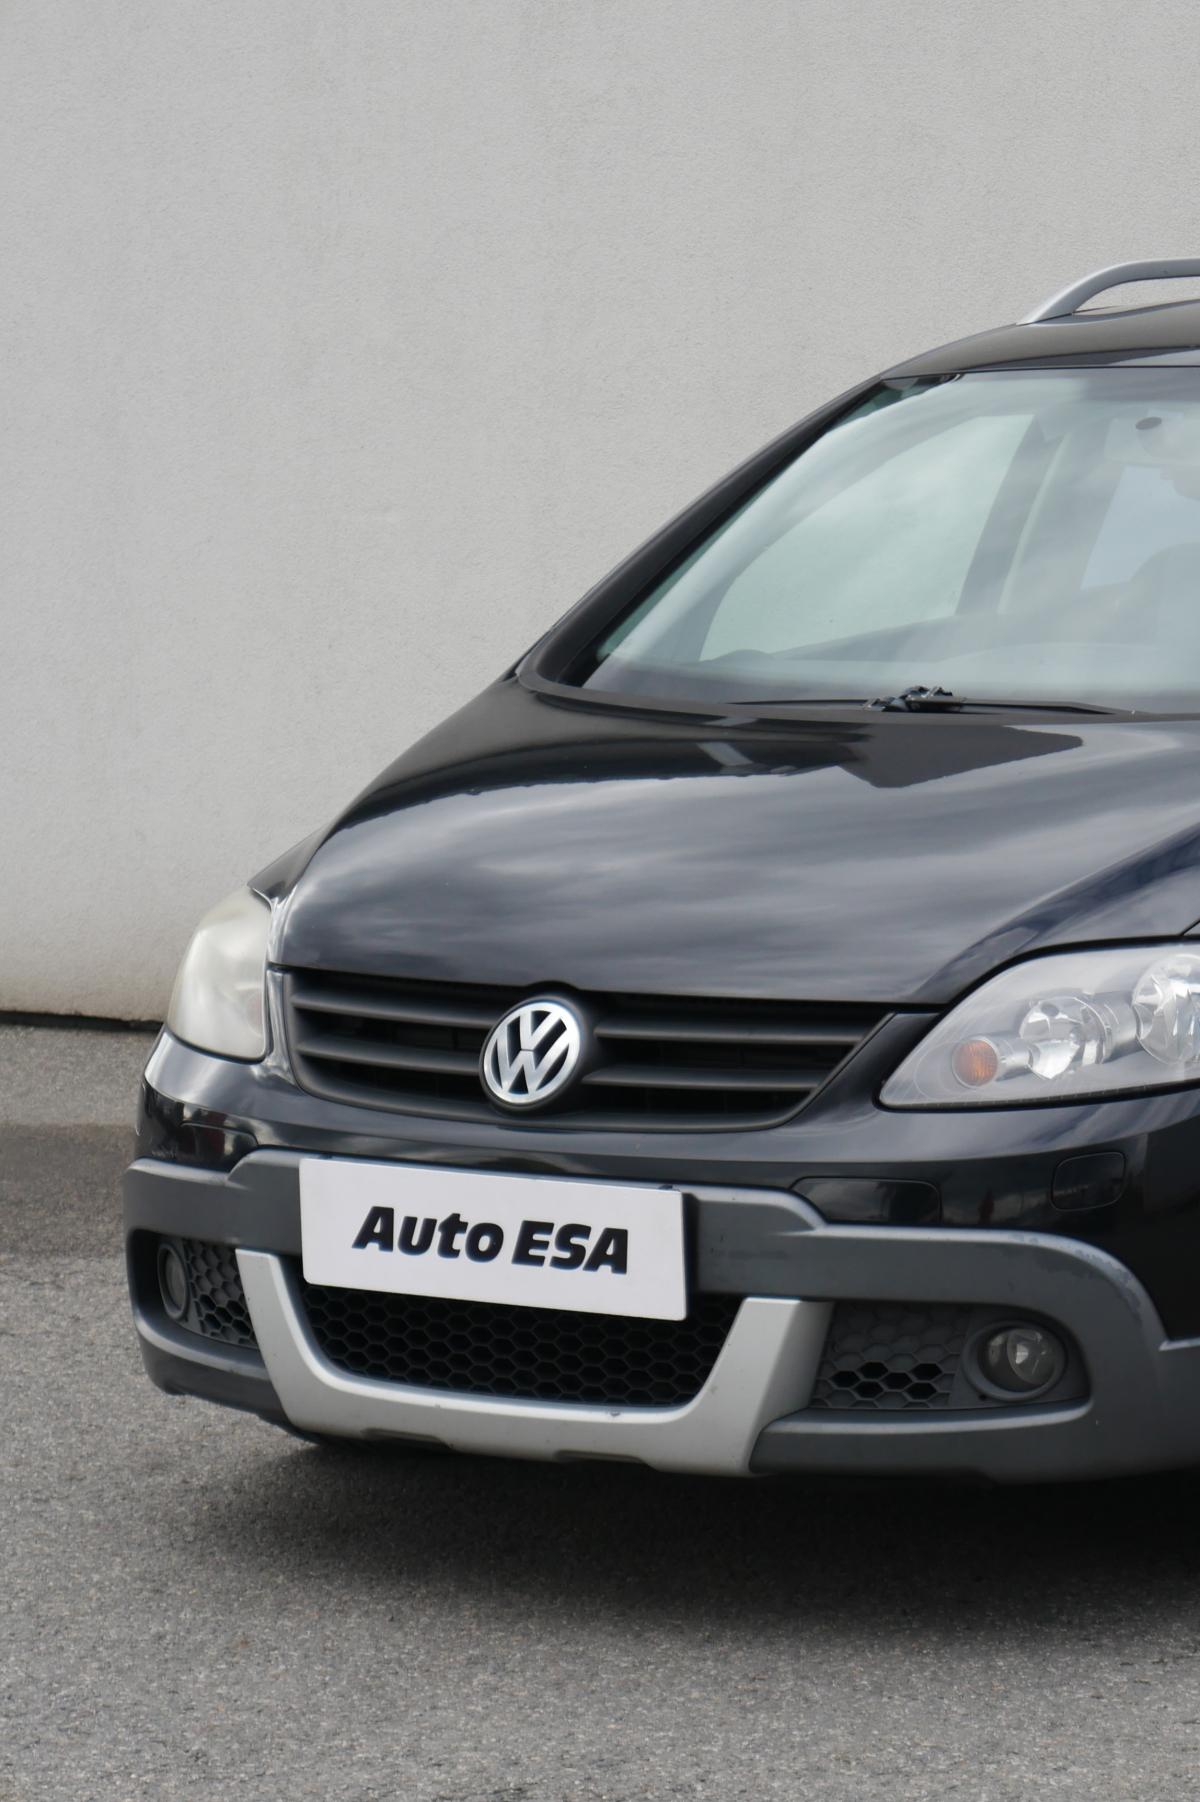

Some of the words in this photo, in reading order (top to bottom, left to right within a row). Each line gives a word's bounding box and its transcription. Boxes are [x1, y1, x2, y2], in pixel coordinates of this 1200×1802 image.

[485, 1003, 578, 1102] VW
[352, 1206, 504, 1263] Auto
[511, 1220, 629, 1275] ESA
